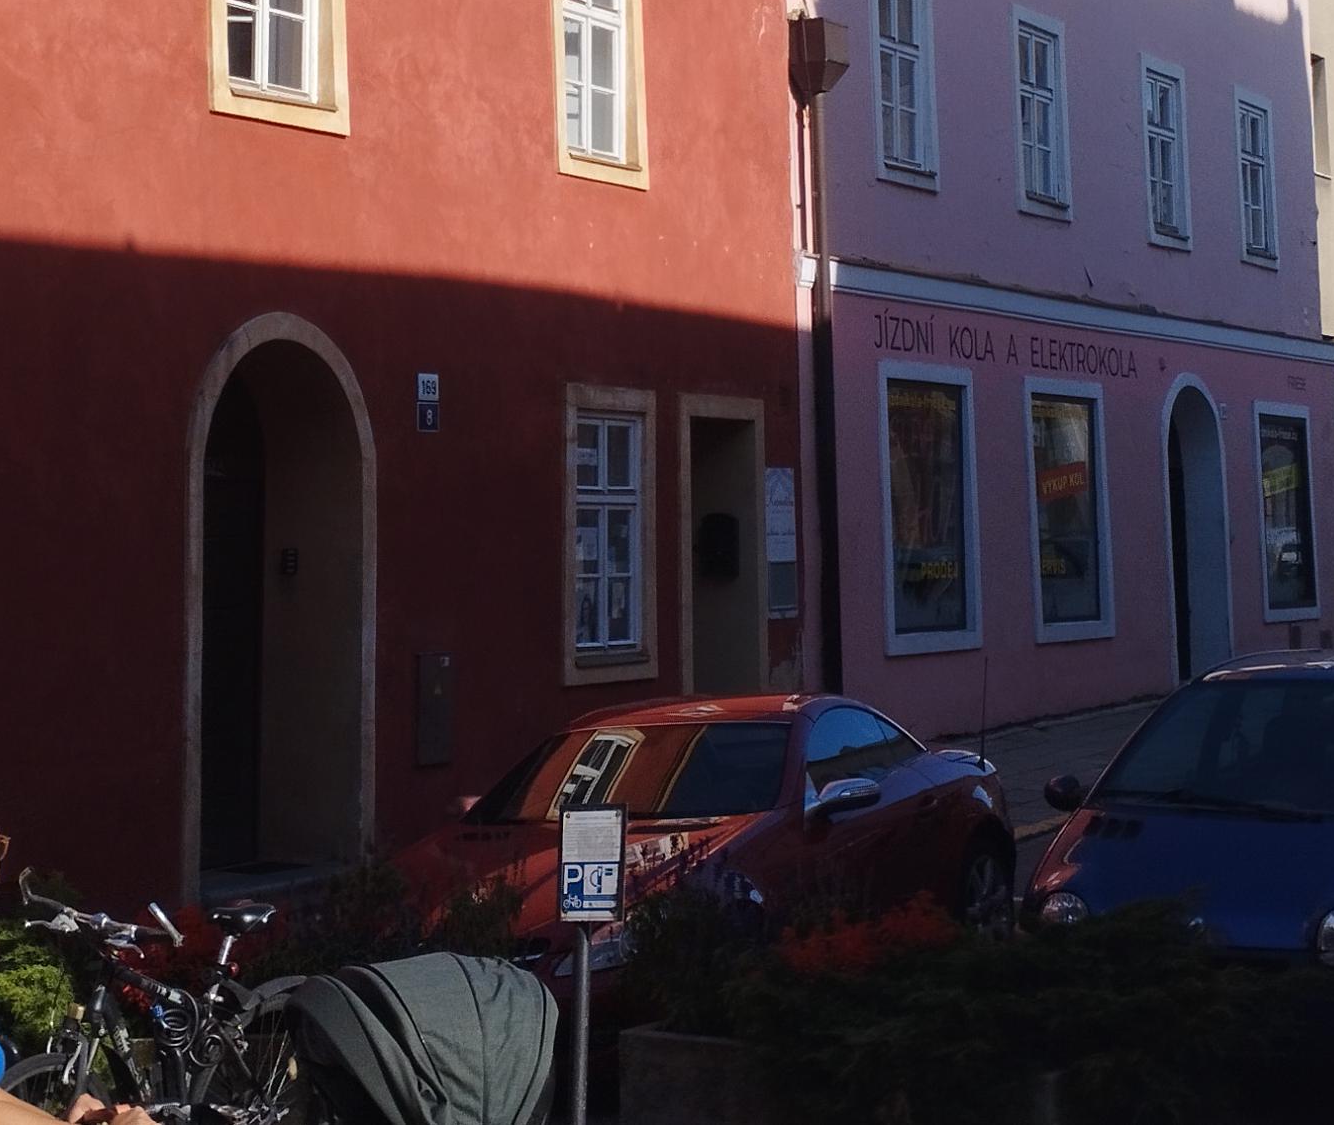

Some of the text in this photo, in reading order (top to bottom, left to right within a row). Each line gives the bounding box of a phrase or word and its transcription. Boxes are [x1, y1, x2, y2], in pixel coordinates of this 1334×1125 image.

[874, 308, 1138, 378] JÍZDNÍ KOLA A ELEKTROKOLA
[563, 864, 583, 895] P
